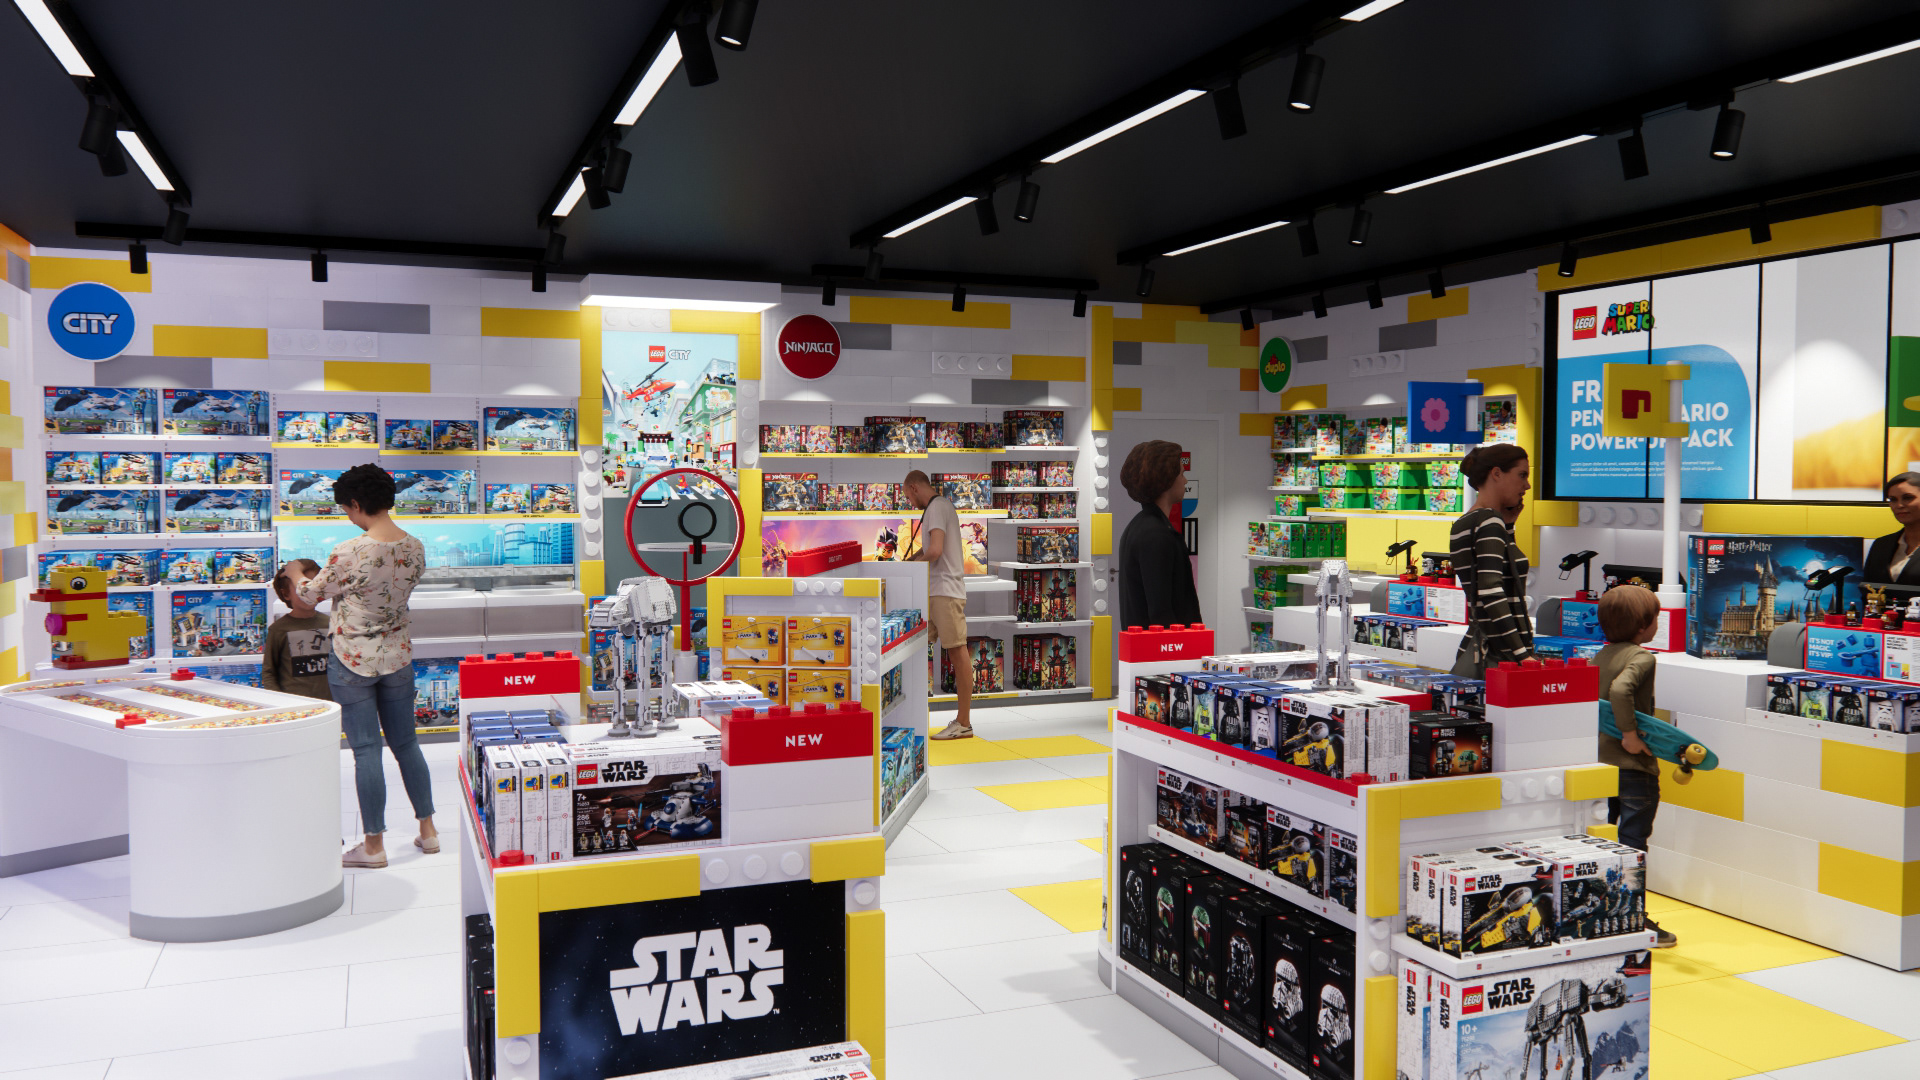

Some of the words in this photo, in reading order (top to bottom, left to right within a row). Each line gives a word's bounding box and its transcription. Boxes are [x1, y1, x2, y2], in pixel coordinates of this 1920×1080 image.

[1609, 299, 1650, 317] SUPER
[1575, 315, 1596, 331] LEGO
[1601, 313, 1655, 336] MARIO
[668, 349, 691, 360] CITY
[783, 341, 836, 356] NINJAGO
[1264, 360, 1286, 376] duplo
[1572, 380, 1602, 404] FR
[1681, 402, 1729, 422] ARIO
[1160, 643, 1184, 652] NEW
[1252, 665, 1279, 674] STAR
[504, 675, 536, 686] NEW
[1542, 682, 1568, 694] NEW
[1291, 700, 1308, 710] STAR
[1291, 705, 1308, 716] WARS
[785, 734, 823, 747] NEW
[602, 760, 648, 773] STAR
[578, 769, 597, 779] LEGO
[602, 770, 648, 783] WARS
[1576, 861, 1598, 871] STAR
[1576, 868, 1598, 876] WARS
[1477, 874, 1502, 885] STAR
[1477, 880, 1502, 890] WARS
[610, 924, 783, 988] STAR
[1487, 977, 1535, 997] STAR
[610, 969, 783, 1036] WARS
[1462, 994, 1482, 1007] LEGO
[1487, 990, 1535, 1010] WARS
[1461, 1024, 1478, 1036] 10+
